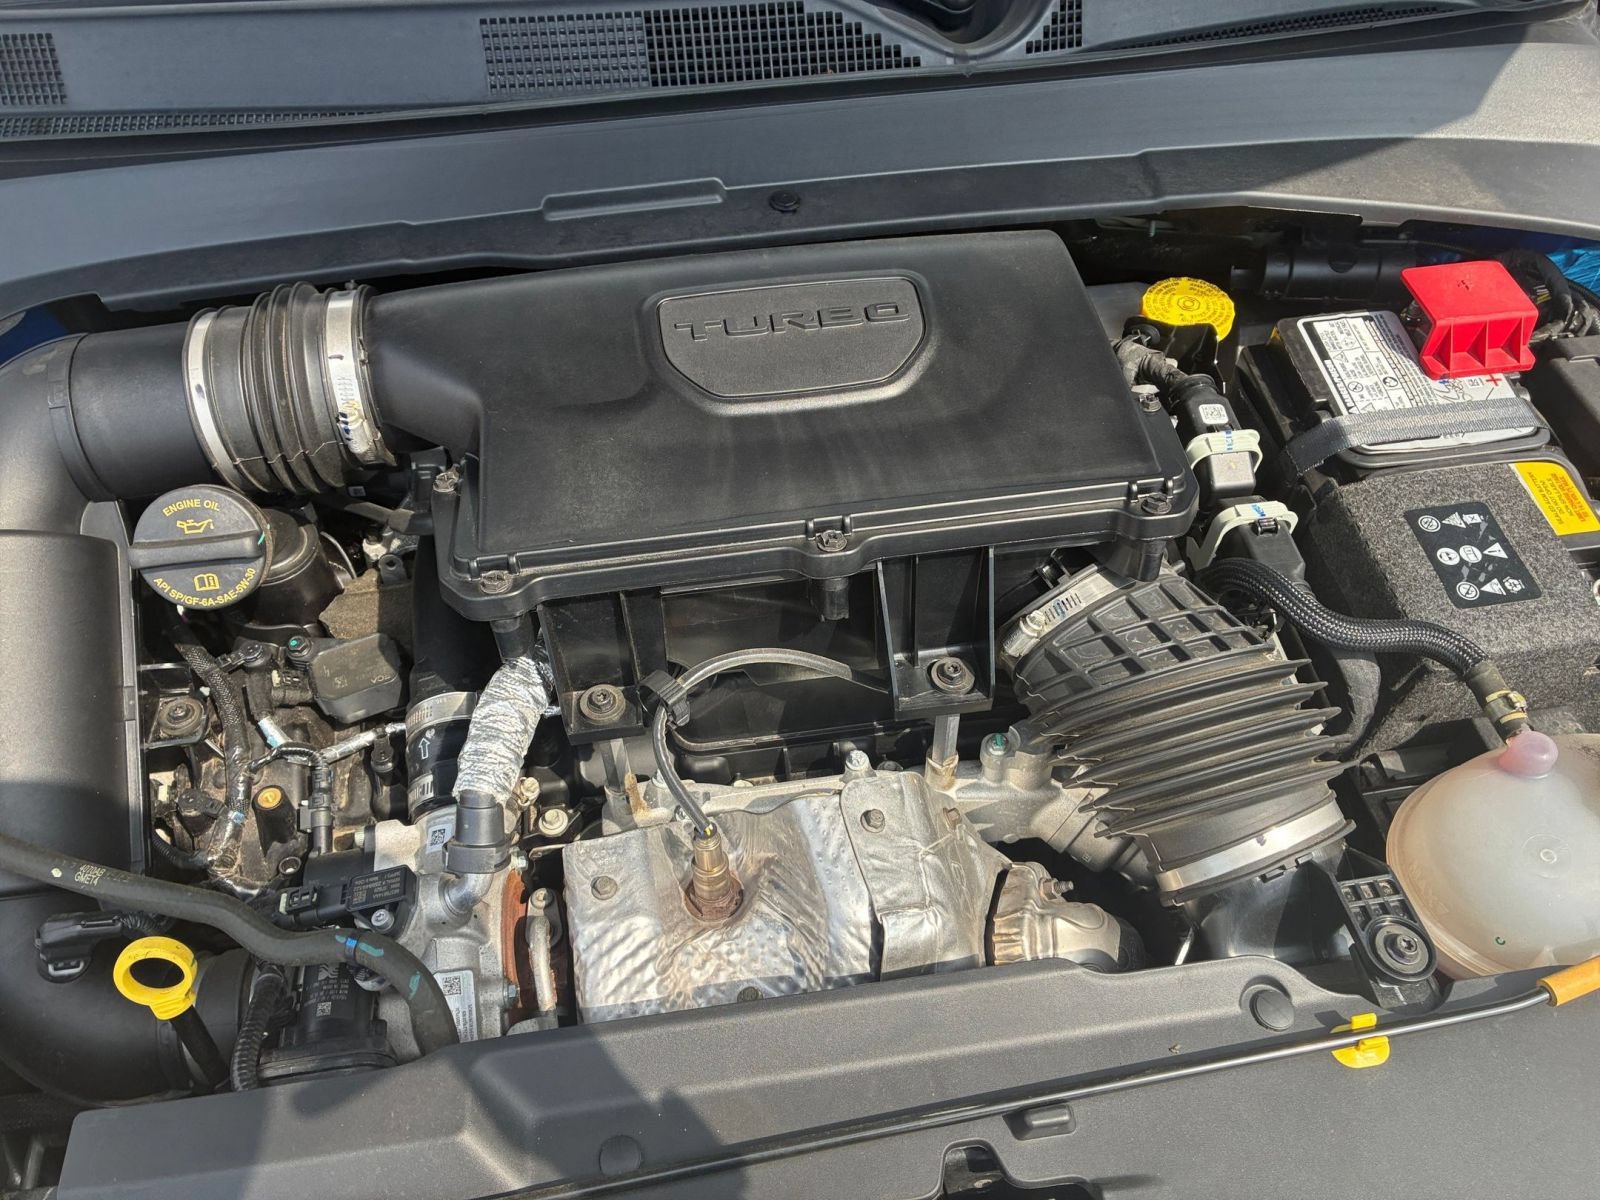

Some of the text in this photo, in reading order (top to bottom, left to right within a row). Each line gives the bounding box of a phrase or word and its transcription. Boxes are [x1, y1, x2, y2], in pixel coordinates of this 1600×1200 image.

[674, 302, 911, 342] TURBO
[162, 499, 220, 517] ENGINE OIL
[154, 578, 170, 593] API
